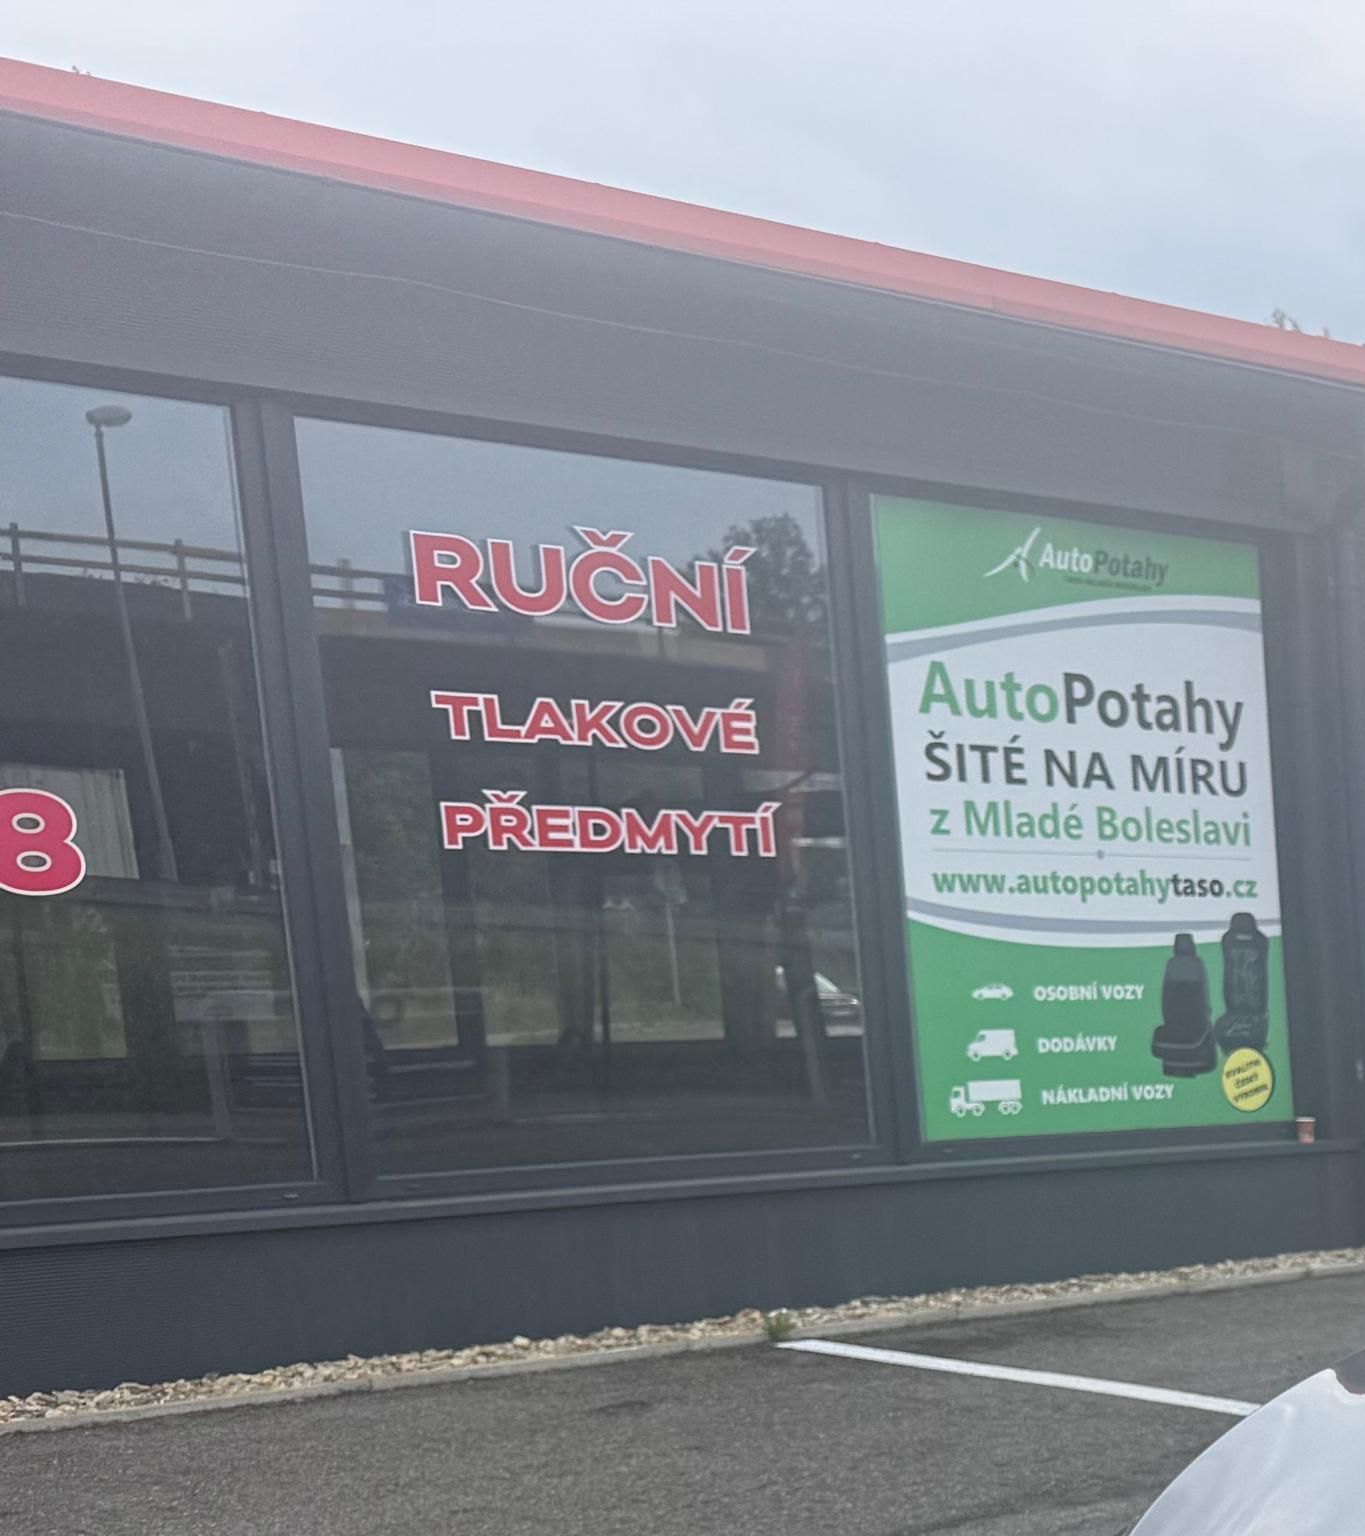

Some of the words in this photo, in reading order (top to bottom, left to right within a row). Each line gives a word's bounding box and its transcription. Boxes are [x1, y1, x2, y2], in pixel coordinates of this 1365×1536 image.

[409, 525, 757, 634] RUČNÍ
[1039, 542, 1168, 587] AutoPotahy
[430, 690, 760, 755] TLAKOVÉ
[918, 660, 1244, 752] AutoPotahy
[924, 730, 1028, 786] ŠITÉ
[1044, 748, 1116, 791] NA
[1130, 746, 1248, 798] MÍRU
[440, 789, 782, 857] PŘEDMYTÍ
[929, 808, 951, 836] z
[963, 800, 1084, 841] Mladé
[1096, 805, 1251, 847] Boleslavi
[931, 869, 1259, 904] www.autopotahytaso.cz
[1033, 981, 1098, 1002] OSOBNÍ
[1102, 985, 1145, 1000] VOZY
[1037, 1033, 1118, 1054] DODÁVKY
[1041, 1083, 1128, 1105] NÁKLADNÍ
[1132, 1084, 1174, 1099] VOZY
